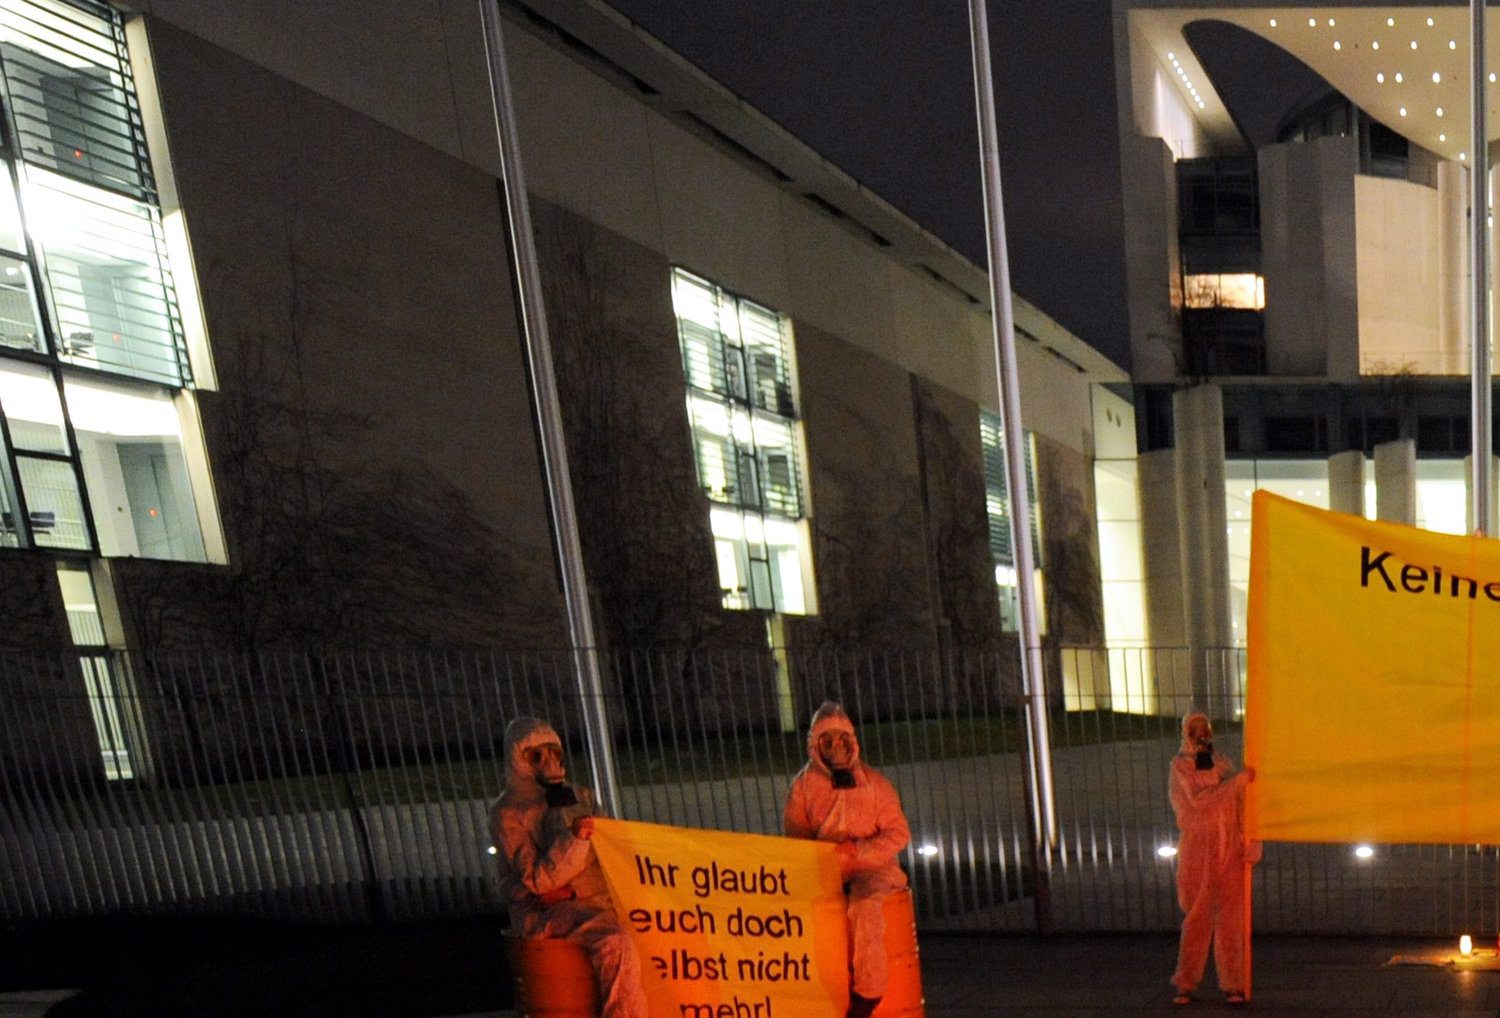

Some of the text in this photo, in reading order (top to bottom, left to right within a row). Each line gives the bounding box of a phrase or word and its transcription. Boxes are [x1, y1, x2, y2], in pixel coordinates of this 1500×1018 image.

[635, 854, 790, 898] Ihr glaubt
[629, 904, 803, 938] euch doch
[650, 949, 811, 982] elbst nicht
